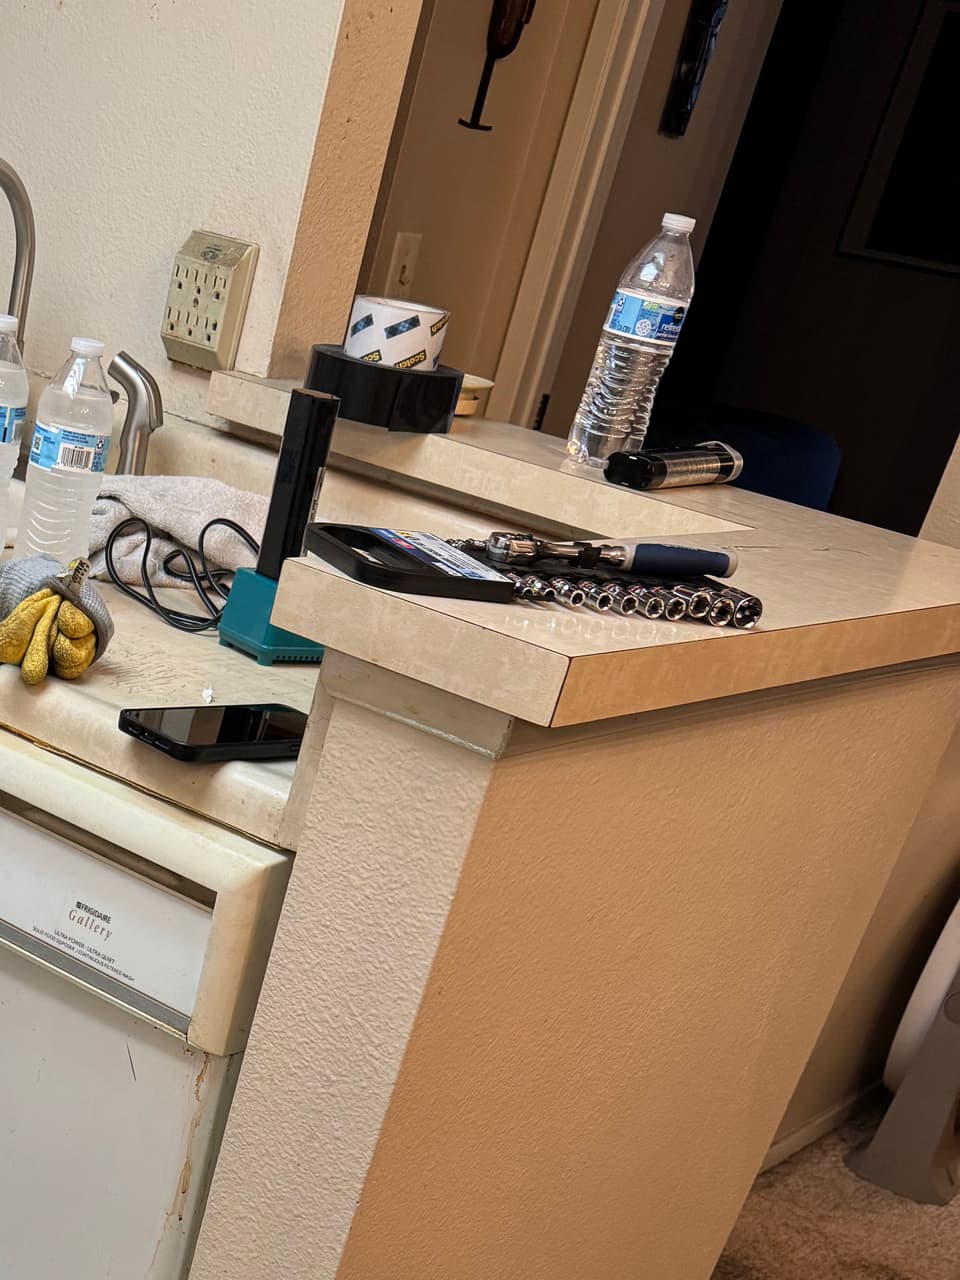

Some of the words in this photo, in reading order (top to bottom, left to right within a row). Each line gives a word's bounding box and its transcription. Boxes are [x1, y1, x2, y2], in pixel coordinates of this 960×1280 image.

[68, 909, 113, 942] Gallery
[80, 903, 112, 925] FRIGIDAIRE
[54, 930, 68, 940] ULTRA
[87, 946, 101, 957] ULTRA
[101, 952, 116, 965] QUIET
